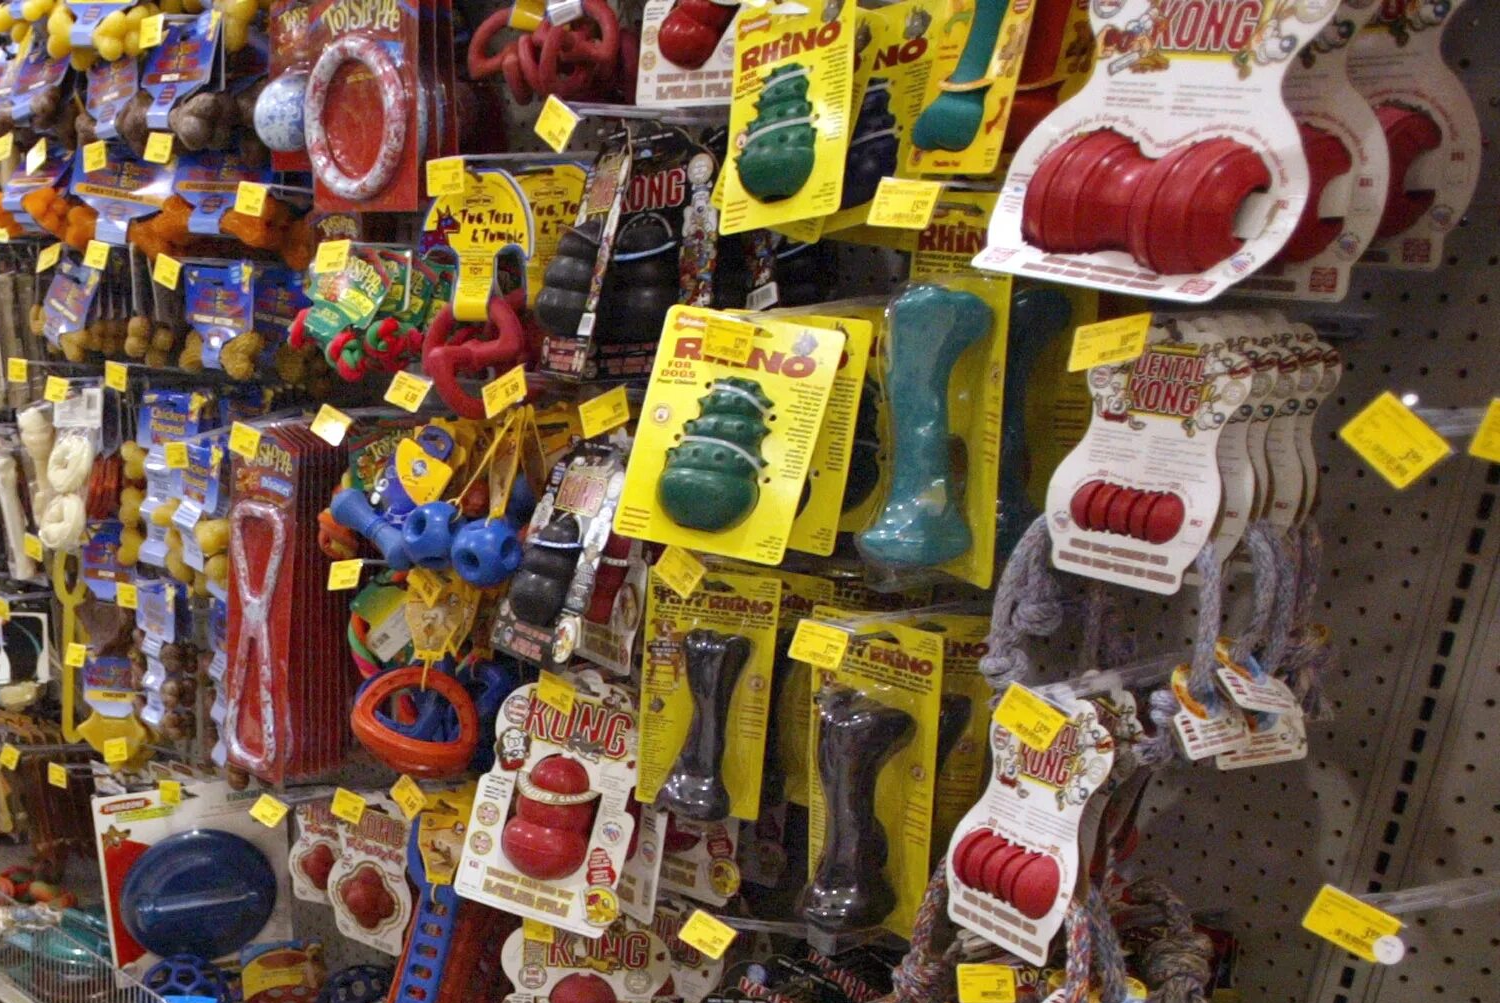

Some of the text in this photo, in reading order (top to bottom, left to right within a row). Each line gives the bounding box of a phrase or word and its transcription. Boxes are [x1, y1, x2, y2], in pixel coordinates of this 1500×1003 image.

[1152, 0, 1263, 51] KONG
[674, 337, 817, 379] RNO
[1133, 352, 1204, 384] DENTAL
[1130, 377, 1201, 417] KONG
[523, 690, 634, 760] KONG
[1021, 742, 1072, 789] KONG
[547, 928, 650, 970] KNG
